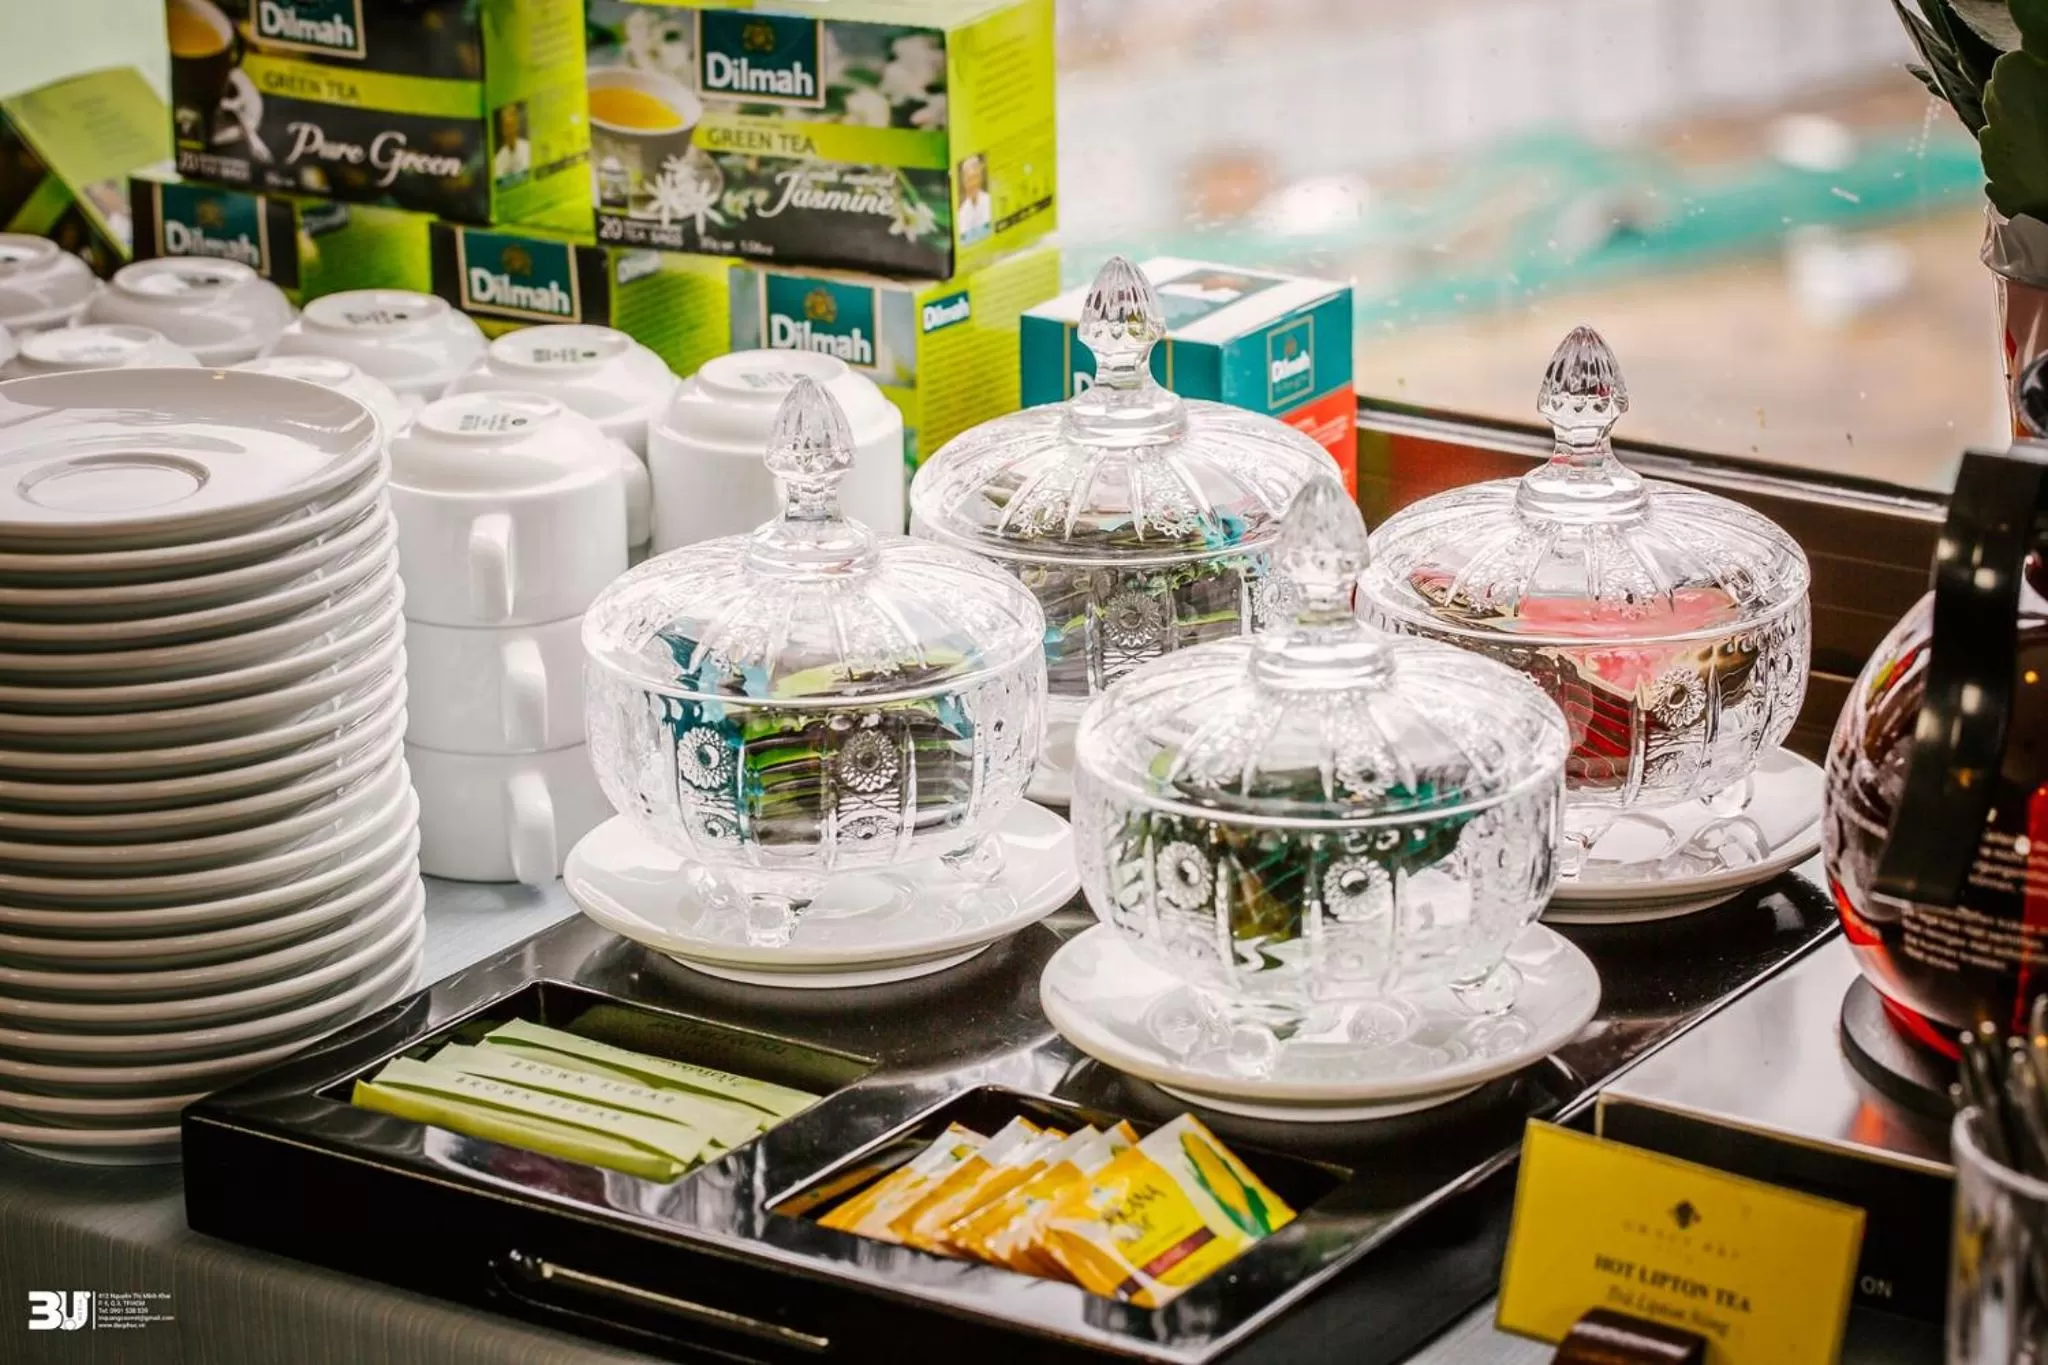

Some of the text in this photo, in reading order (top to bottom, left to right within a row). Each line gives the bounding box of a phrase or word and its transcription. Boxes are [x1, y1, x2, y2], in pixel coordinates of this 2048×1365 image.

[260, 0, 355, 47] Dilmah
[263, 69, 321, 93] GREEN
[326, 79, 360, 98] TEA
[706, 51, 814, 96] Dilmah
[286, 122, 462, 186] Pure Green
[707, 127, 818, 154] GREEN TEA
[756, 170, 895, 218] Jasmine
[164, 219, 261, 266] Dilmah
[600, 216, 624, 240] 20
[470, 266, 571, 315] Dilmah
[770, 312, 873, 364] Dilmah
[454, 1076, 622, 1122] BROWN SUGAR
[509, 1060, 677, 1105] BROWN SUGAR
[1594, 1253, 1753, 1314] HOT LIPTON TEA
